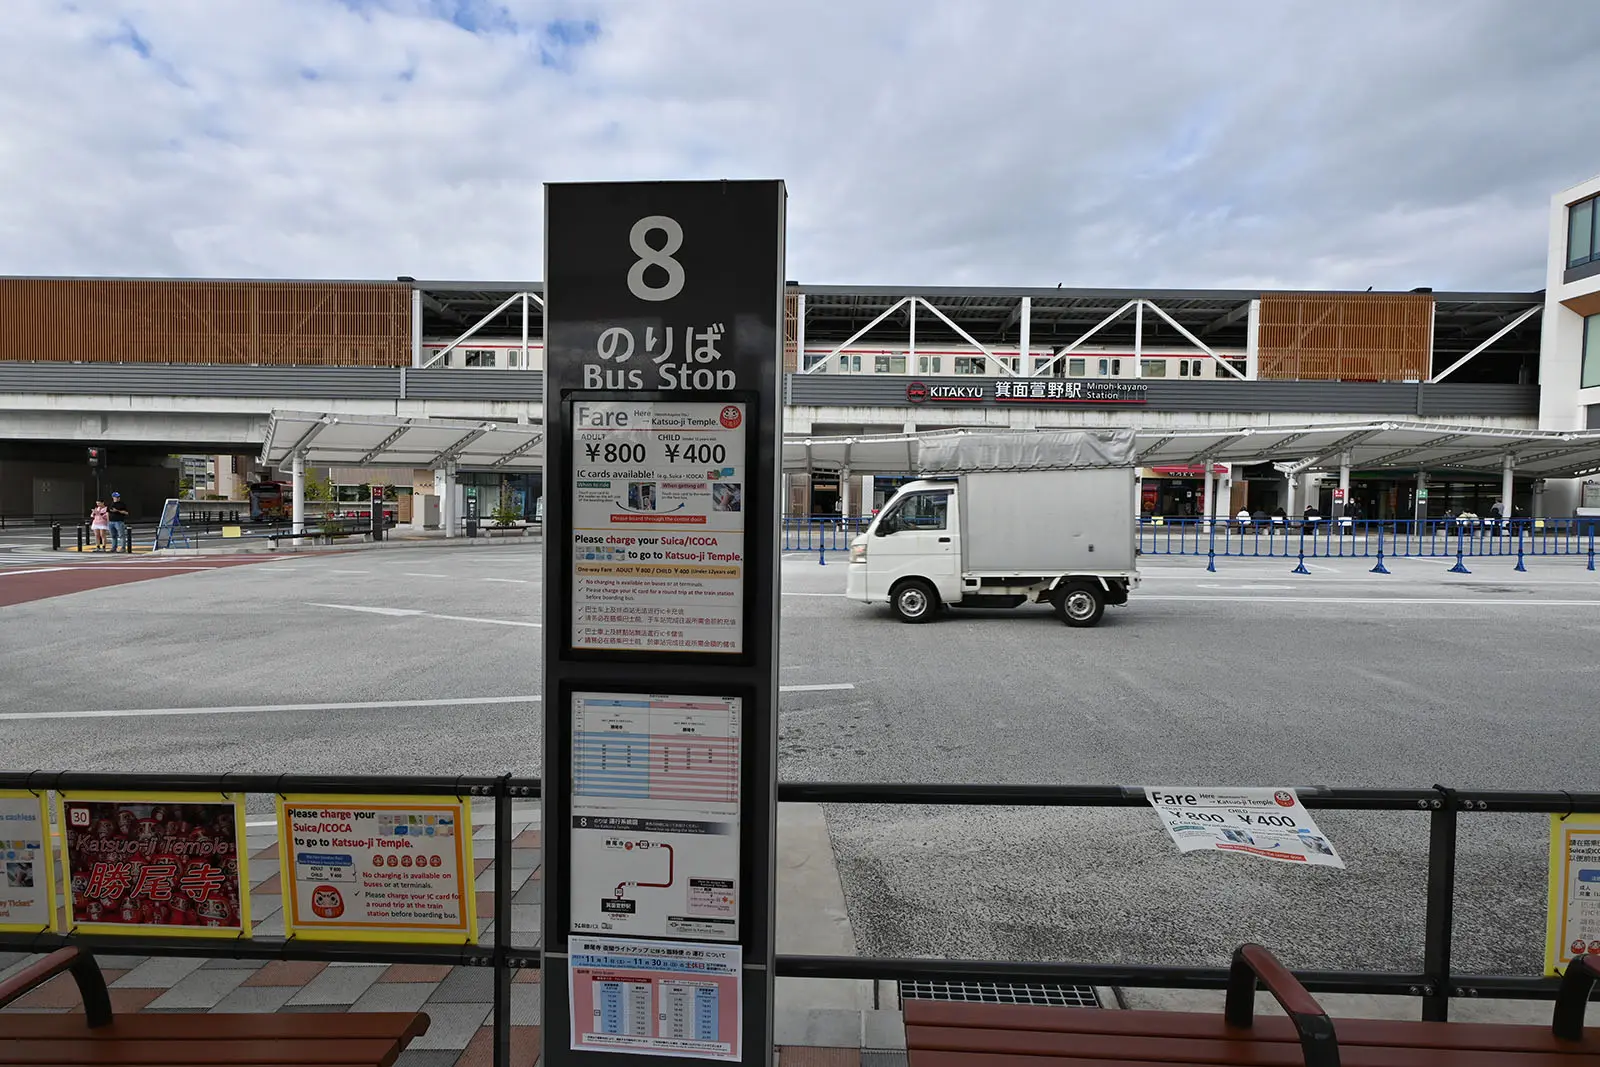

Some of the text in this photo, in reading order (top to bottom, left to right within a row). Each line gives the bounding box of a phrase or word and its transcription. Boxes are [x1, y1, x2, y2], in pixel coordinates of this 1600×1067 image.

[627, 215, 685, 301] 8
[597, 323, 725, 364] のりば
[584, 364, 643, 389] Bus
[930, 386, 983, 398] KITAKYU
[996, 381, 1082, 398] 箕面萱野駅
[1087, 383, 1148, 392] Minoh-kayano
[578, 407, 628, 426] Fare
[651, 418, 718, 428] Katsuo-ji Temple.
[586, 444, 646, 462] ¥800
[665, 444, 726, 463] ¥400
[577, 470, 586, 478] IC
[588, 470, 610, 478] cards
[612, 470, 654, 479] available!
[575, 535, 718, 546] Please charge your Suica/ICOCA
[665, 552, 705, 562] Katsuo-ji
[707, 552, 743, 562] Temple.
[1151, 791, 1197, 806] Fare
[74, 812, 87, 822] 30
[288, 810, 375, 820] Please charge your
[1237, 814, 1296, 827] ¥400
[580, 817, 587, 827] 8
[293, 823, 352, 833] Suica/ICOCA
[76, 834, 158, 855] Katsuo-ji
[319, 838, 330, 846] to
[332, 838, 374, 848] Katsuo-ji
[376, 838, 413, 849] Temple.
[84, 862, 225, 902] 勝尾寺
[374, 872, 401, 881] charging
[414, 911, 443, 919] boarding
